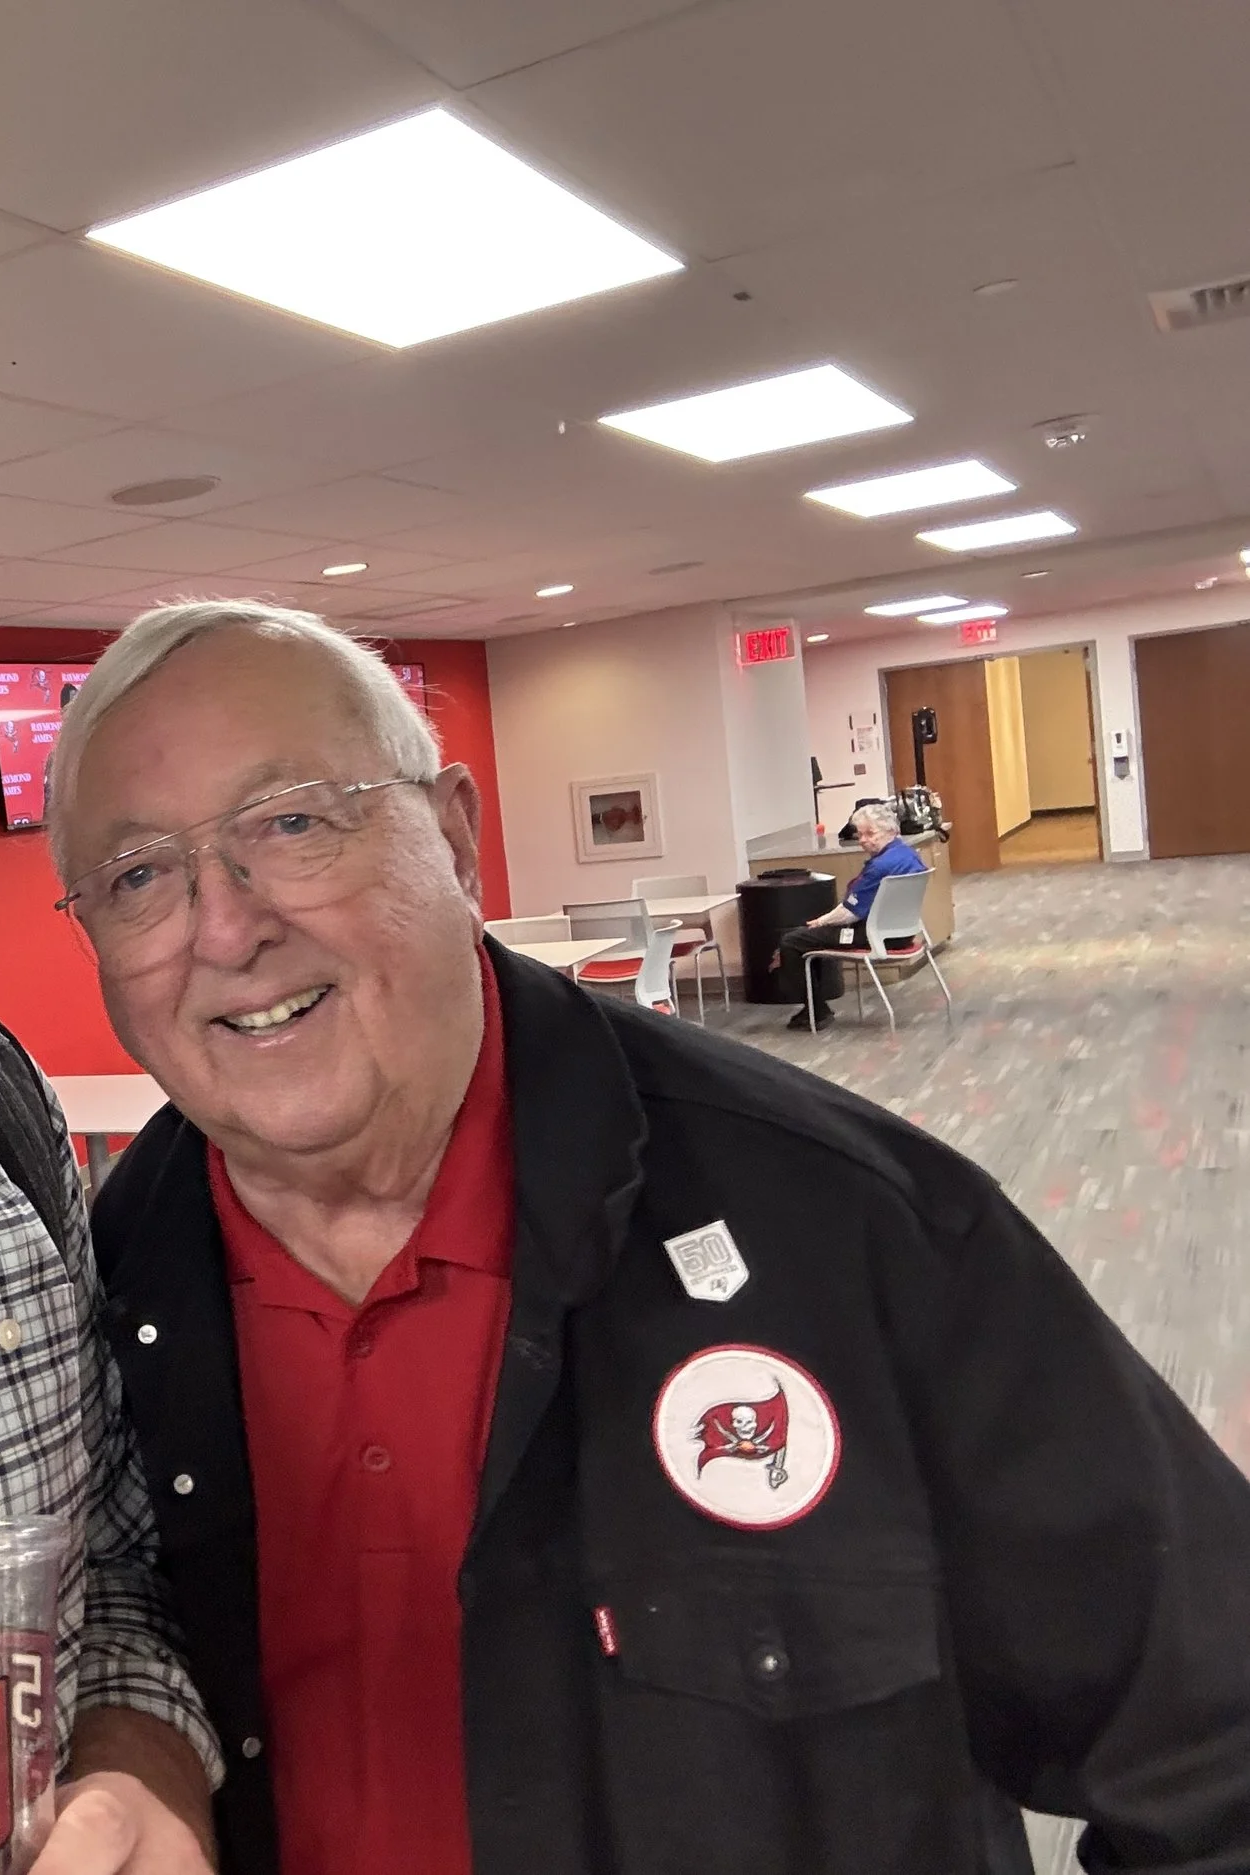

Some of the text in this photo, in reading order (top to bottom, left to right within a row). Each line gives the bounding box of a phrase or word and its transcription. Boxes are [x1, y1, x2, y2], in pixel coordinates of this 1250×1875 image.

[745, 628, 789, 660] EXIT
[61, 672, 91, 682] RAYMON
[2, 773, 32, 784] AYMOND
[4, 785, 22, 795] AMES
[672, 1233, 733, 1276] 50
